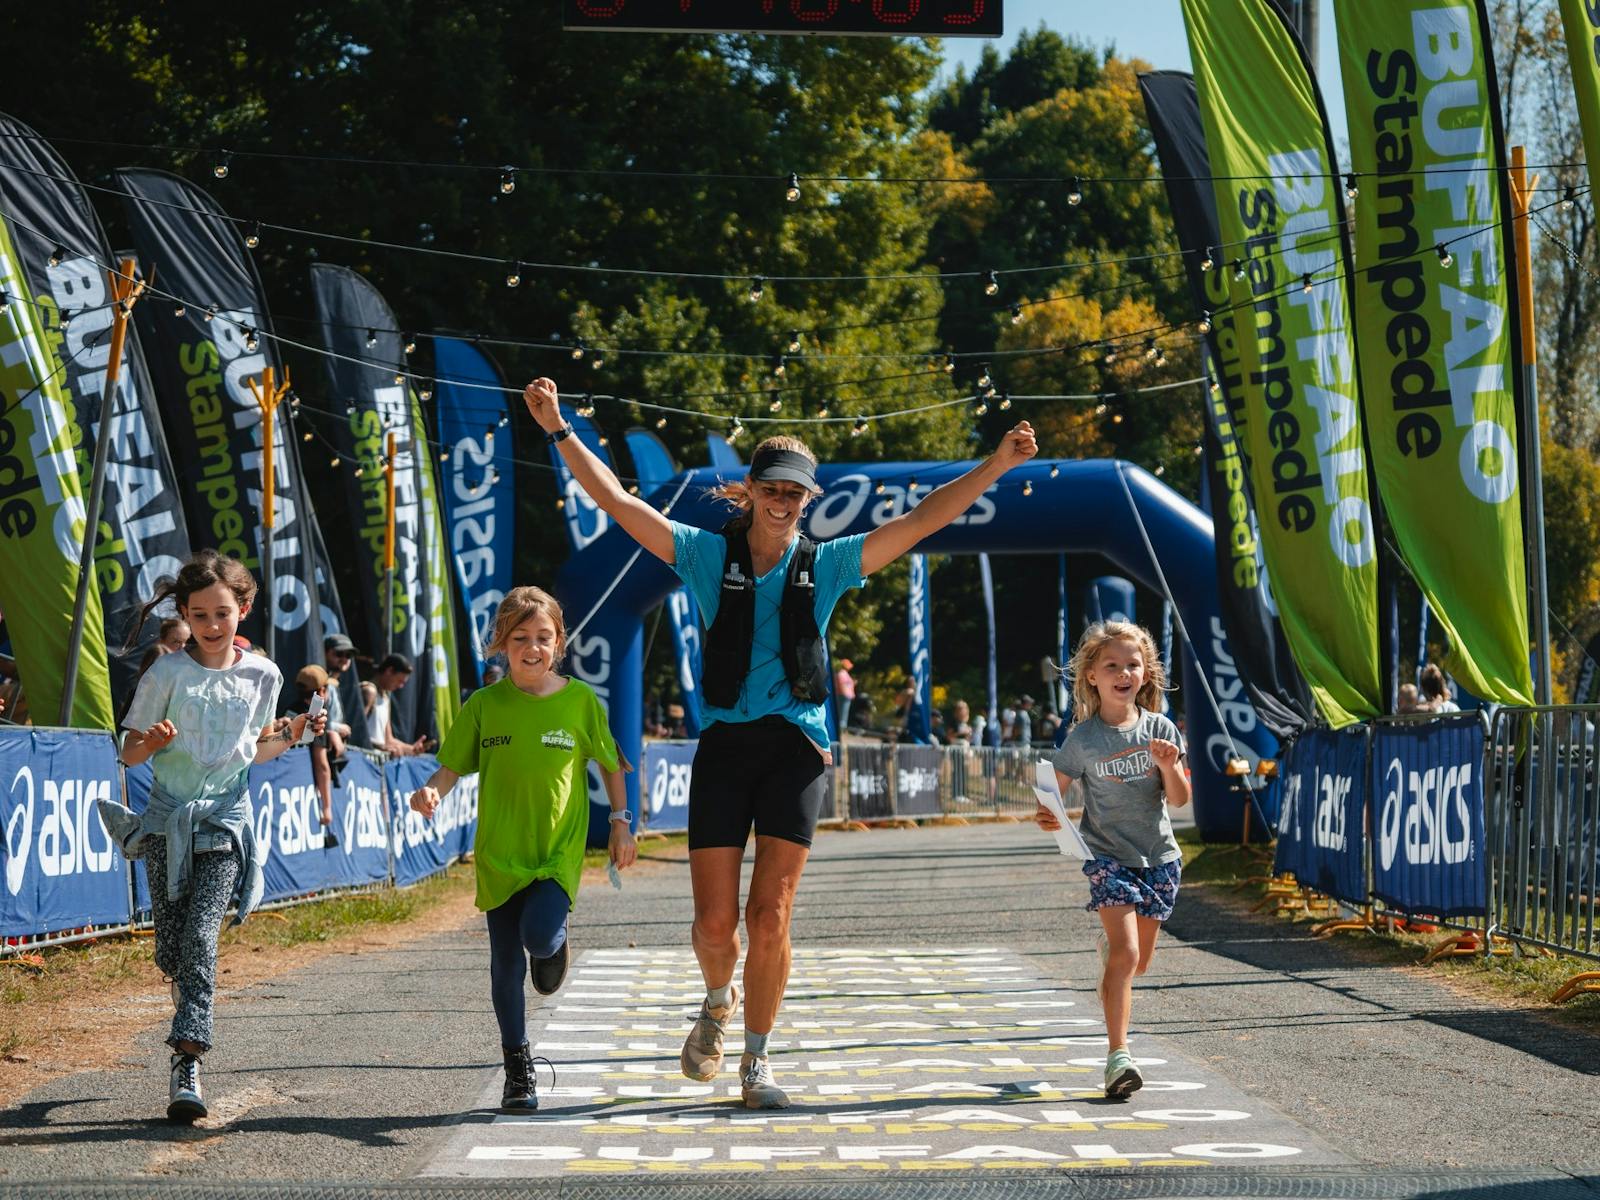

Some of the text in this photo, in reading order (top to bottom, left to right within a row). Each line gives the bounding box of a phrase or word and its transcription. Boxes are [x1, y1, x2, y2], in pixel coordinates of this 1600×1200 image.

[1239, 188, 1322, 533] Stampede
[1268, 149, 1374, 567] BUFFALO
[1367, 48, 1452, 459] Stampede
[1411, 5, 1518, 504] BUFFALO
[179, 339, 260, 570] Stamped
[482, 735, 512, 749] CREW
[465, 1142, 1302, 1162] BUFFALO
[493, 1108, 1252, 1126] BUFFALO
[581, 1120, 1170, 1136] Stampede
